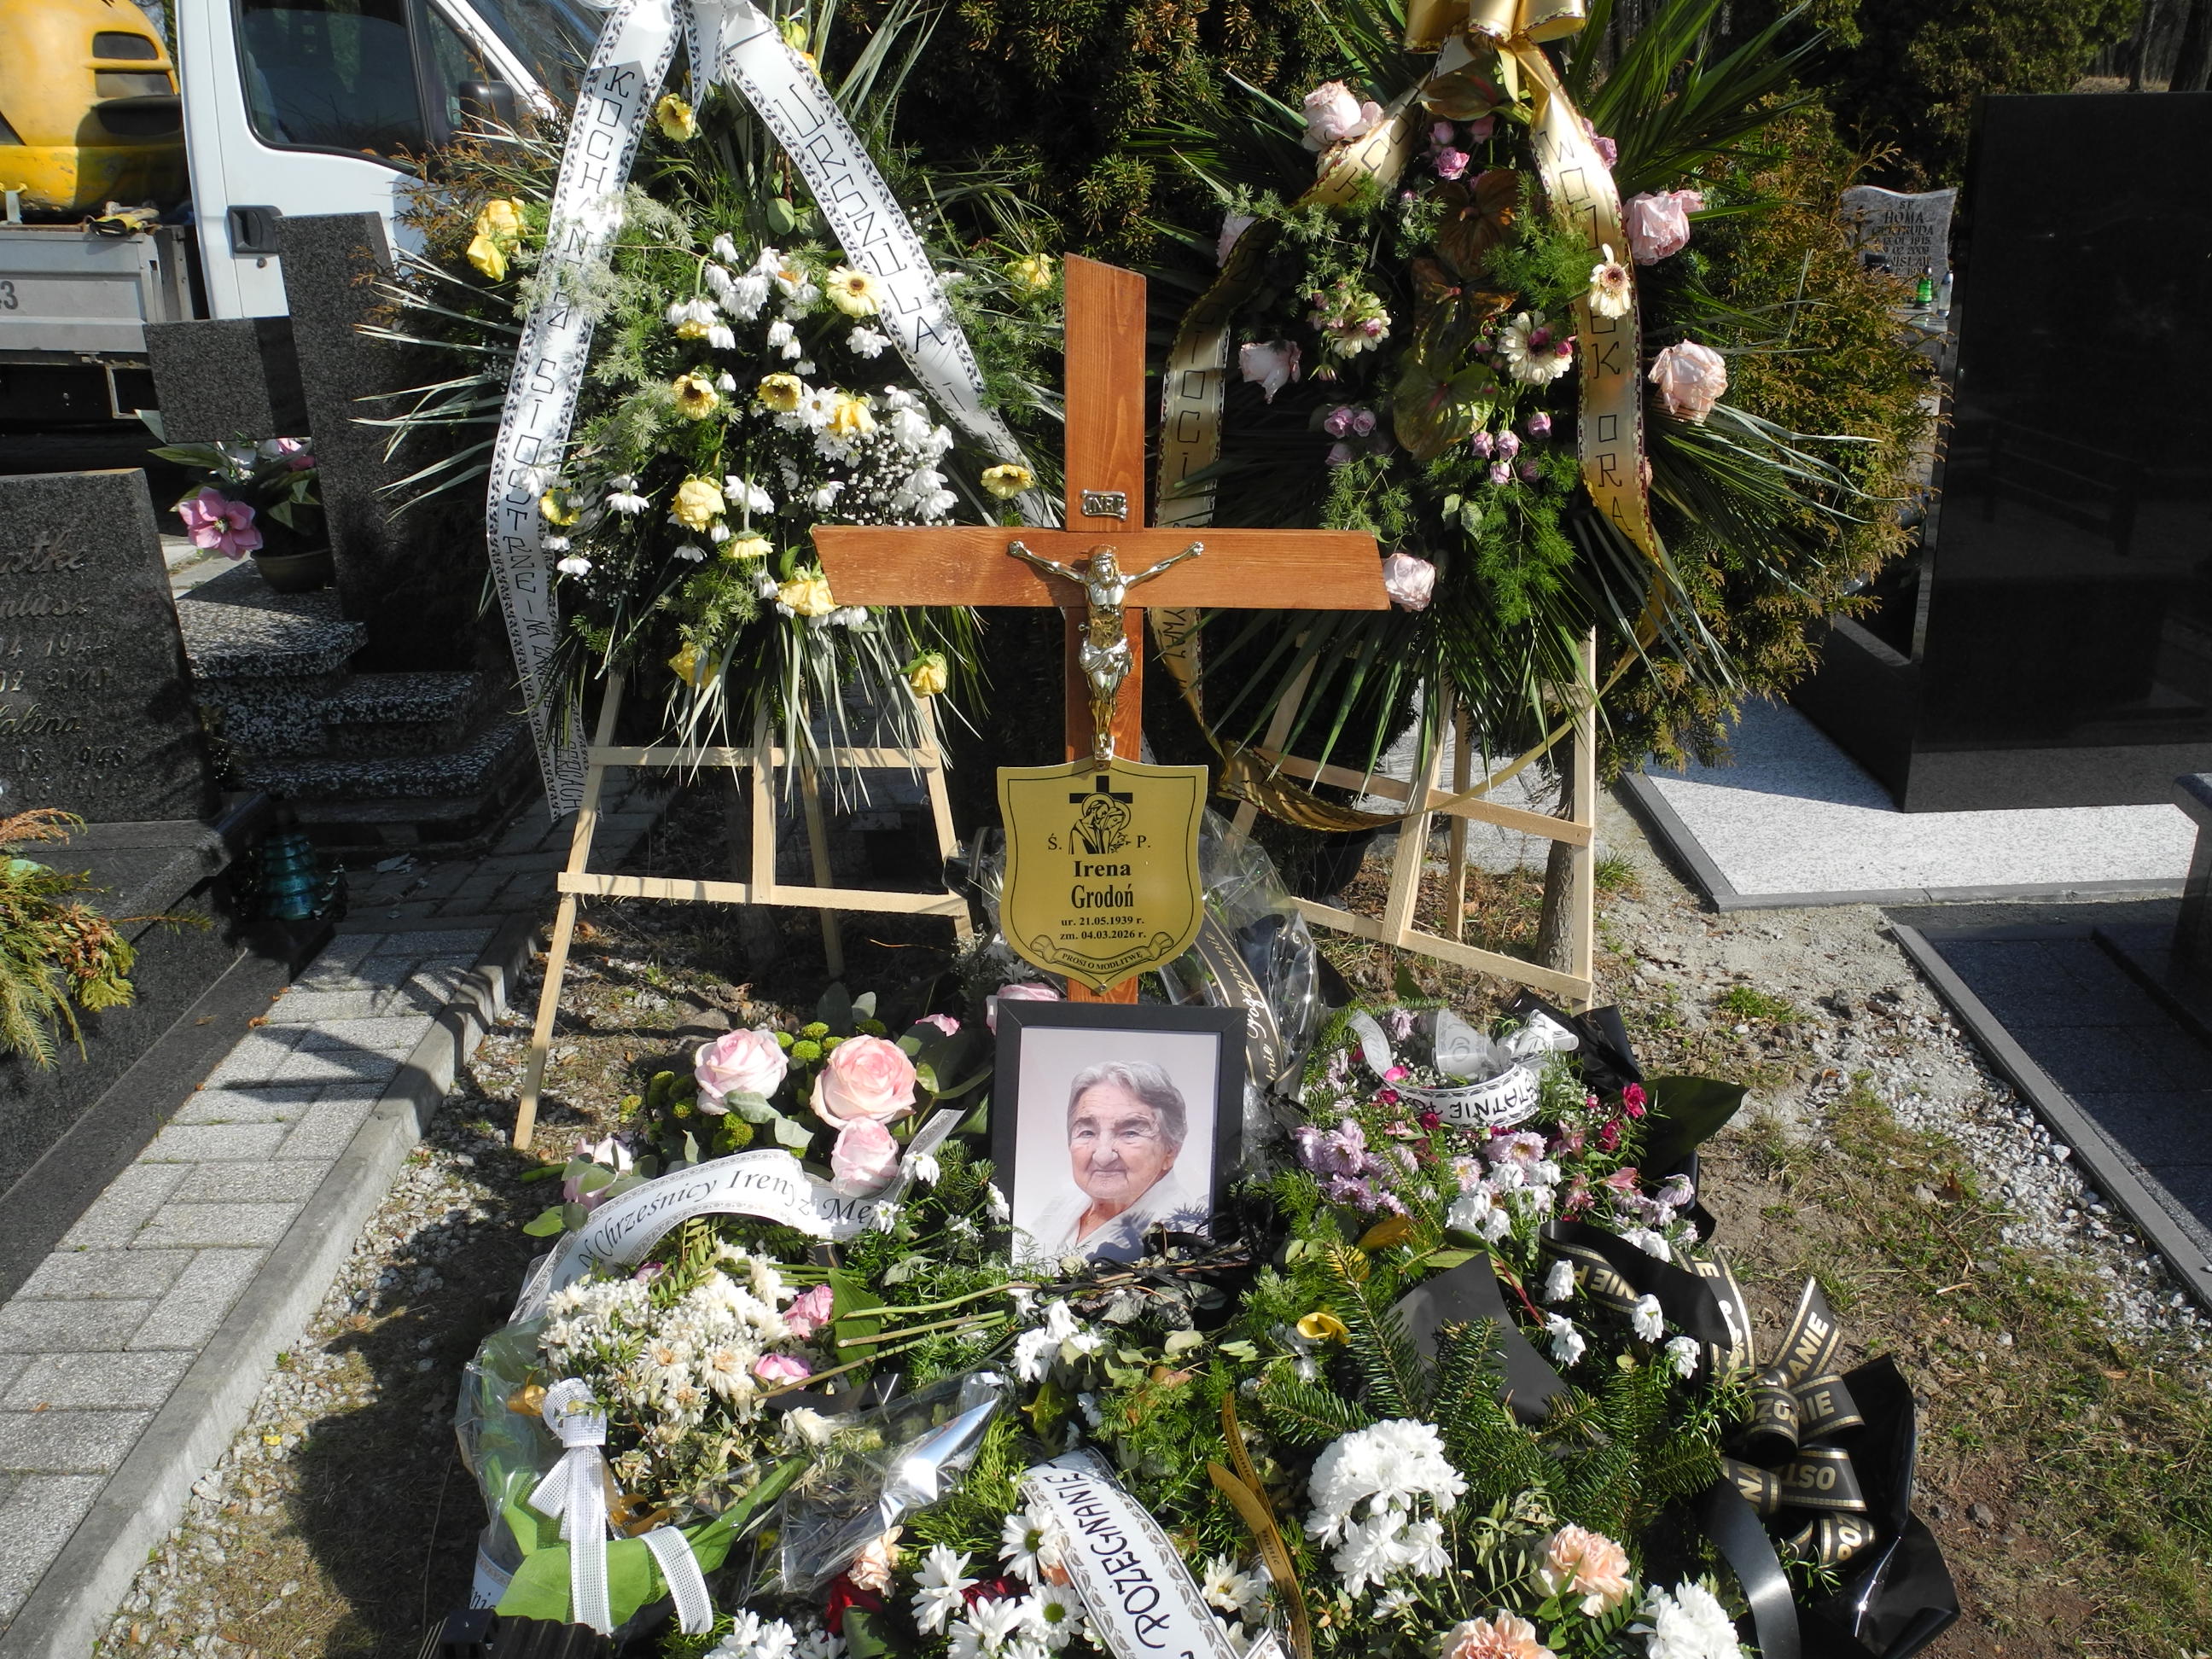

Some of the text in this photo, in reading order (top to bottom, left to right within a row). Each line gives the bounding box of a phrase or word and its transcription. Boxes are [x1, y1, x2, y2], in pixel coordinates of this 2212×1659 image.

[1884, 211, 1924, 224] HOMA
[0, 280, 18, 310] 3
[1595, 414, 1635, 543] ORA
[0, 701, 81, 736] alina
[1047, 833, 1151, 851] Ś. P.
[1073, 860, 1132, 877] Irena
[1071, 883, 1134, 909] Grodoń
[1079, 917, 1133, 926] 21.05.1939
[1080, 930, 1135, 940] 04.03.2026
[1062, 953, 1086, 968] PROSI
[1096, 952, 1144, 970] MODLITWĘ
[594, 1179, 717, 1257] Chrześnicy
[1042, 1472, 1172, 1650] POŻEGNANIE
